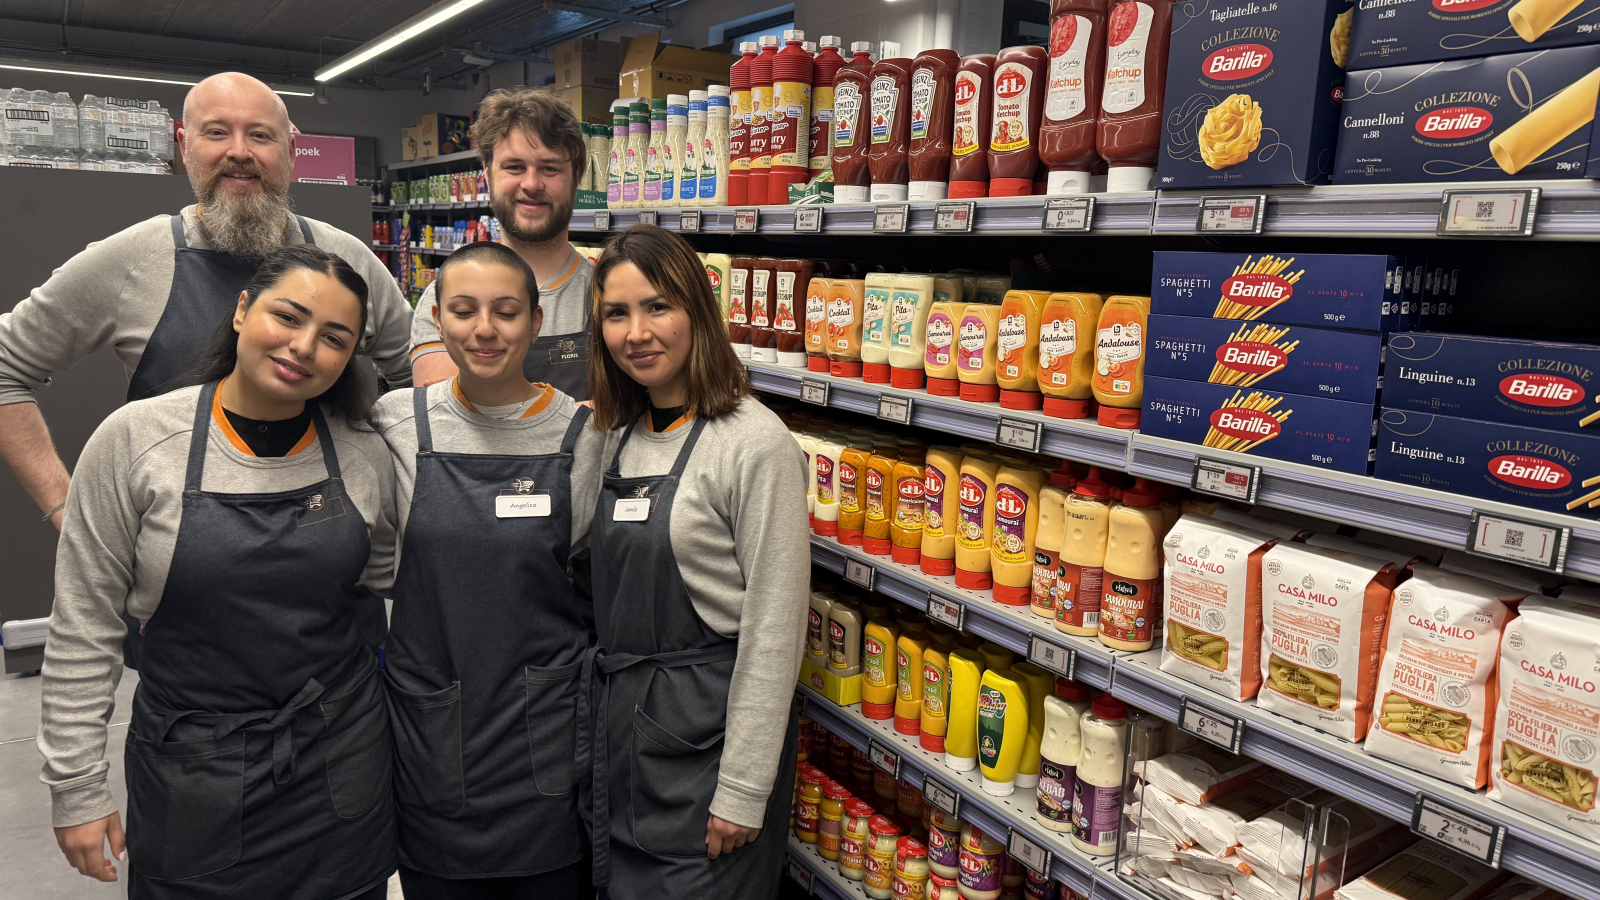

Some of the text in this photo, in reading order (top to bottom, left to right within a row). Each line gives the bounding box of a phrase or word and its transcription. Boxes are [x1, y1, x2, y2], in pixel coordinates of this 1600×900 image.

[1210, 2, 1277, 22] Tagliatelle n.16
[1379, 9, 1395, 19] n.88
[1202, 26, 1280, 52] COLLEZIONE
[1118, 48, 1140, 60] Everyday
[1210, 51, 1264, 73] Barilla
[1050, 77, 1081, 89] Ketchup
[1108, 68, 1141, 79] Ketchup
[836, 101, 854, 109] TOMATO
[873, 96, 890, 104] TOMATO
[1414, 92, 1501, 112] COLLEZIONE
[997, 110, 1020, 118] Ketchup
[1344, 112, 1404, 128] Cannelloni
[1424, 113, 1482, 132] Barilla
[751, 139, 767, 148] urry
[771, 135, 786, 144] urry
[1363, 131, 1380, 139] n.88
[1161, 278, 1211, 289] SPAGHETTI
[1229, 281, 1283, 298] Barilla
[829, 308, 850, 317] Cocktail
[1041, 334, 1075, 342] Andalouse
[1098, 339, 1140, 348] Andalouse
[1155, 341, 1206, 353] SPAGHETTI
[1224, 348, 1278, 367] Barilla
[1334, 362, 1342, 370] 10
[1399, 367, 1476, 386] Linguine n.13
[1498, 359, 1593, 382] COLLEZIONE
[1508, 380, 1573, 400] Barilla
[1151, 402, 1200, 417] SPAGHETTI
[1218, 413, 1272, 435] Barilla
[1391, 441, 1465, 465] Linguine n.13
[1486, 440, 1580, 466] COLLEZIONE
[1497, 460, 1560, 484] Barilla
[510, 502, 537, 510] Angelica
[1176, 553, 1224, 574] CASA MILO
[1183, 600, 1201, 610] FILIERA
[1278, 584, 1338, 607] CASA MILO
[1170, 601, 1200, 621] PUGLIA
[1408, 615, 1475, 640] CASA MILO
[1272, 634, 1308, 657] PUGLIA
[1288, 633, 1309, 646] FILIERA
[1393, 669, 1435, 694] PUGLIA
[1396, 662, 1437, 682] 100% FILIERA
[1520, 660, 1596, 693] CASA MILO
[1508, 709, 1558, 735] 100% FILIERA
[1507, 717, 1557, 747] PUGLIA
[1039, 779, 1065, 798] KEBAB
